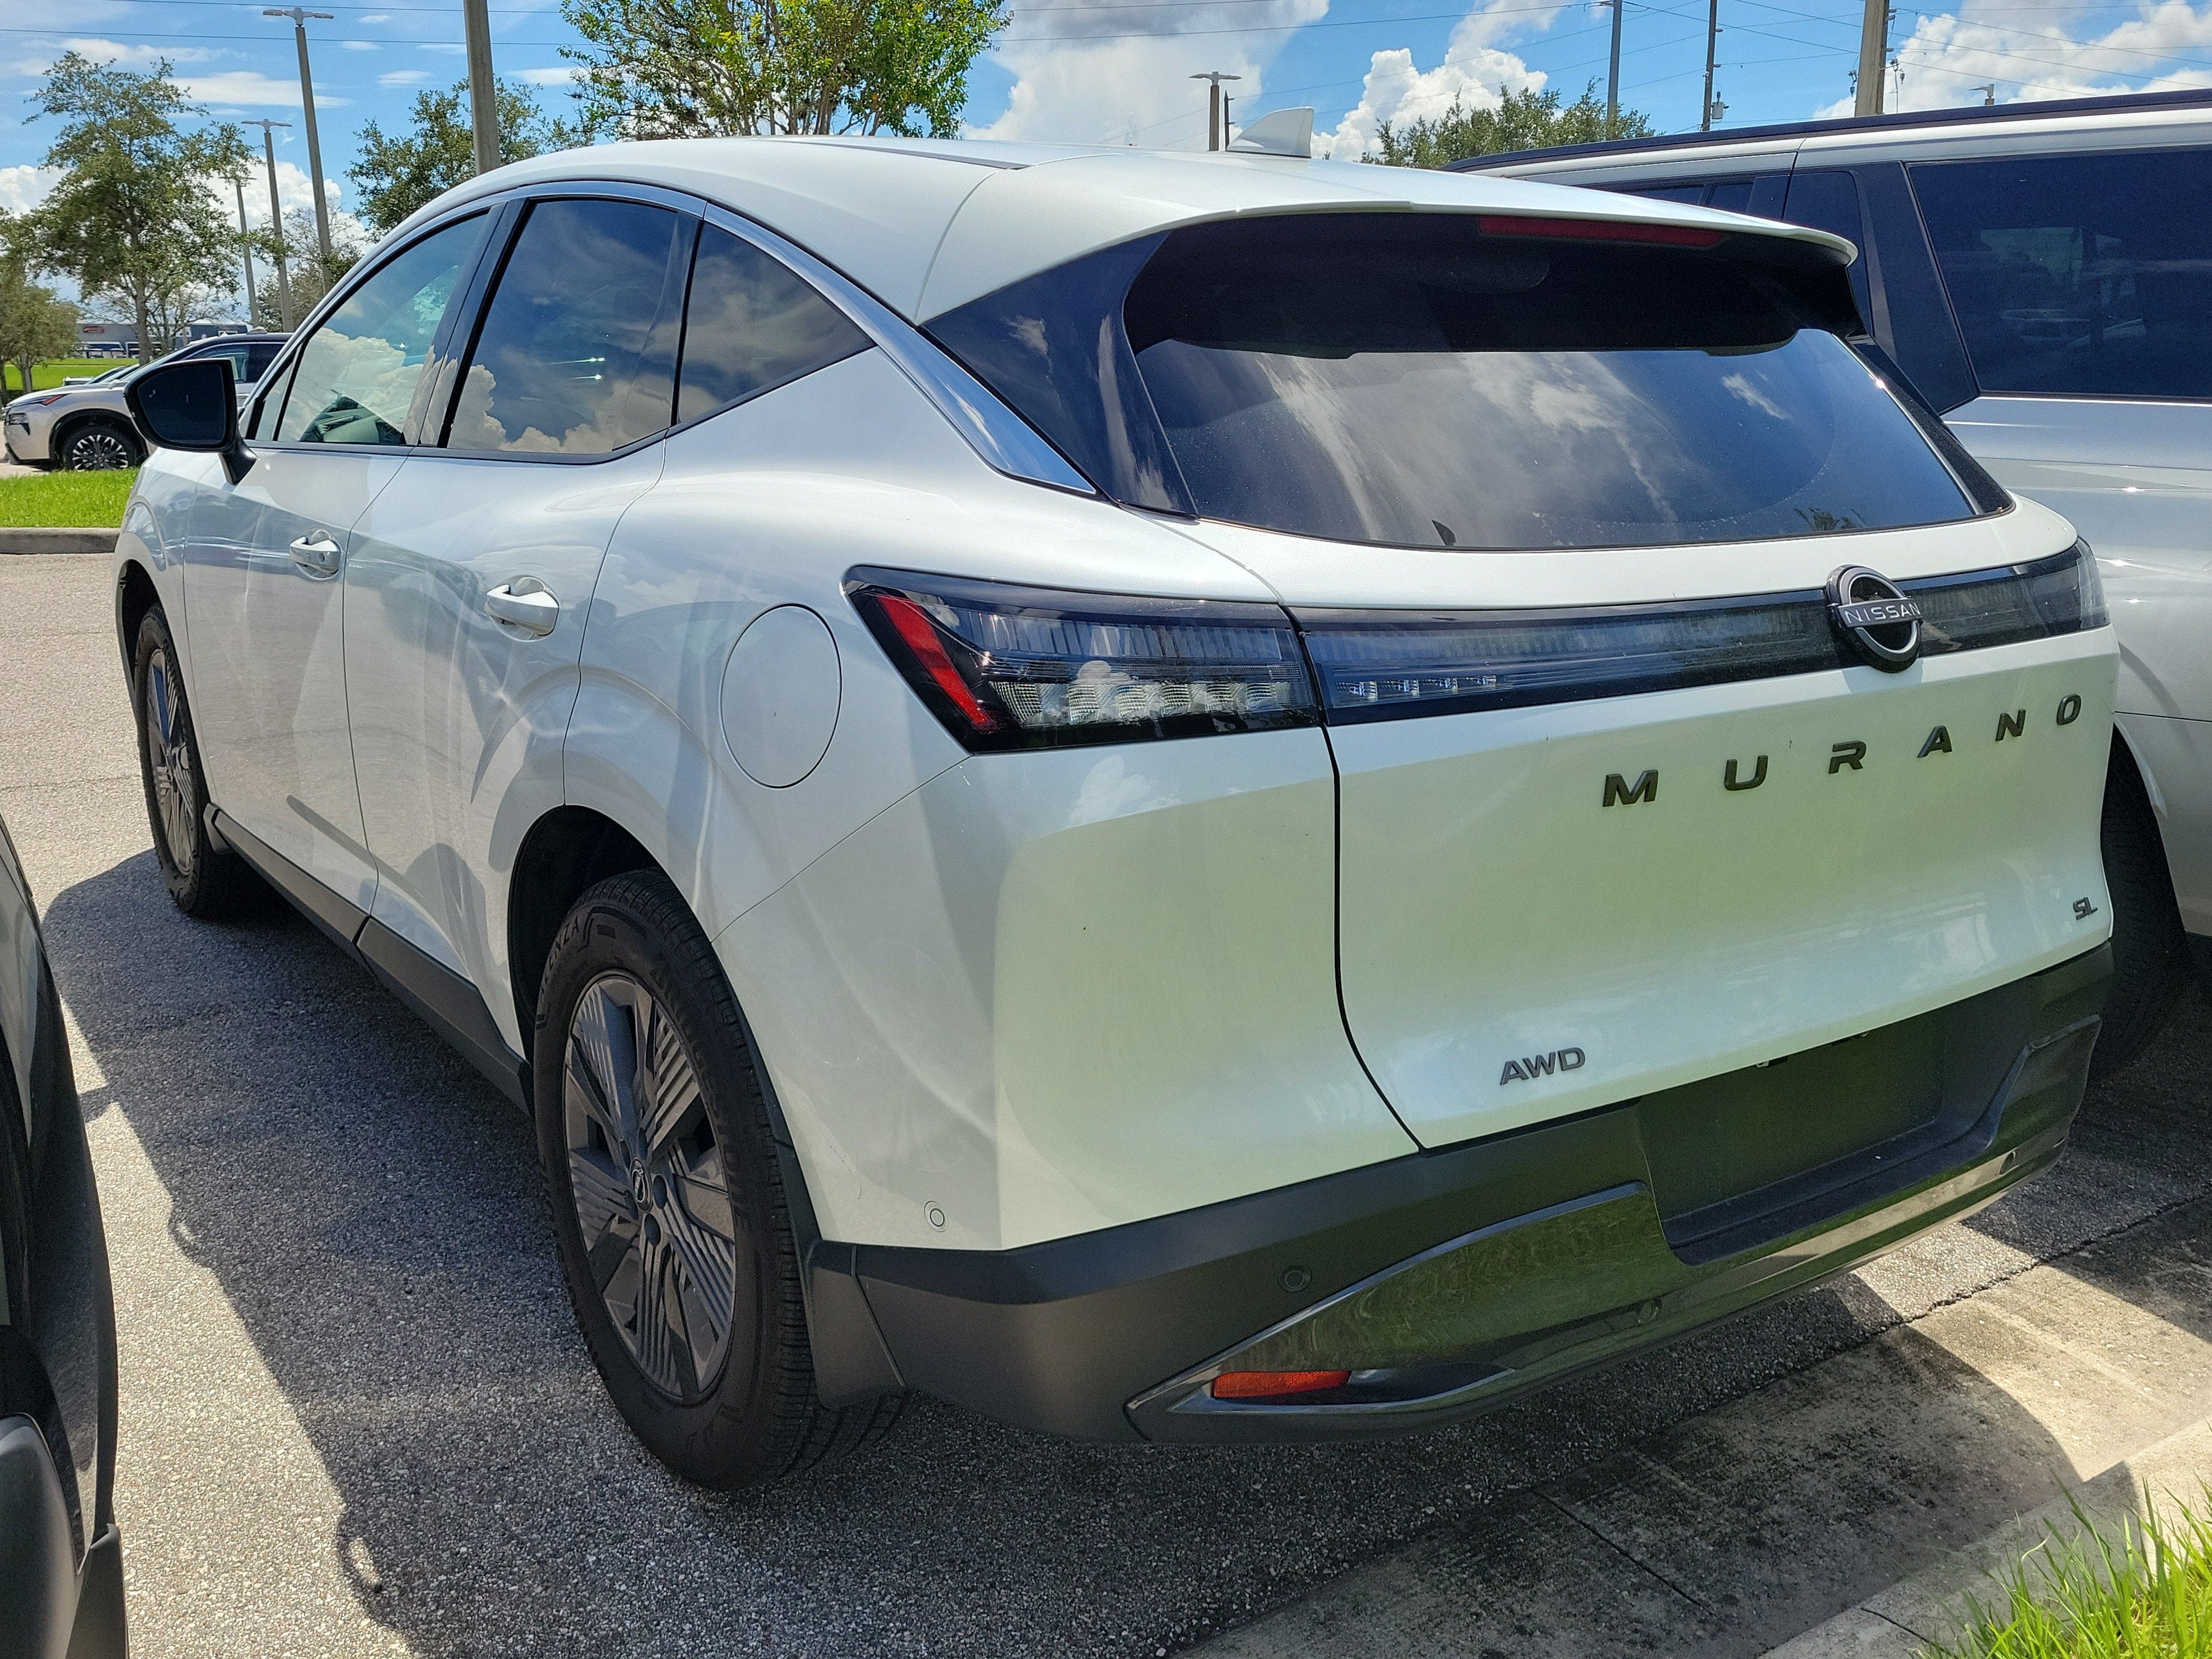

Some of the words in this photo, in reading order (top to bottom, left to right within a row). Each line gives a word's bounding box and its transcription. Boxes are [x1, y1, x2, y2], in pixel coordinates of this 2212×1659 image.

[1844, 602, 1921, 624] NISSAN
[1602, 694, 2082, 808] MURANO
[2073, 896, 2098, 921] SL
[1499, 1046, 1586, 1086] AWD
